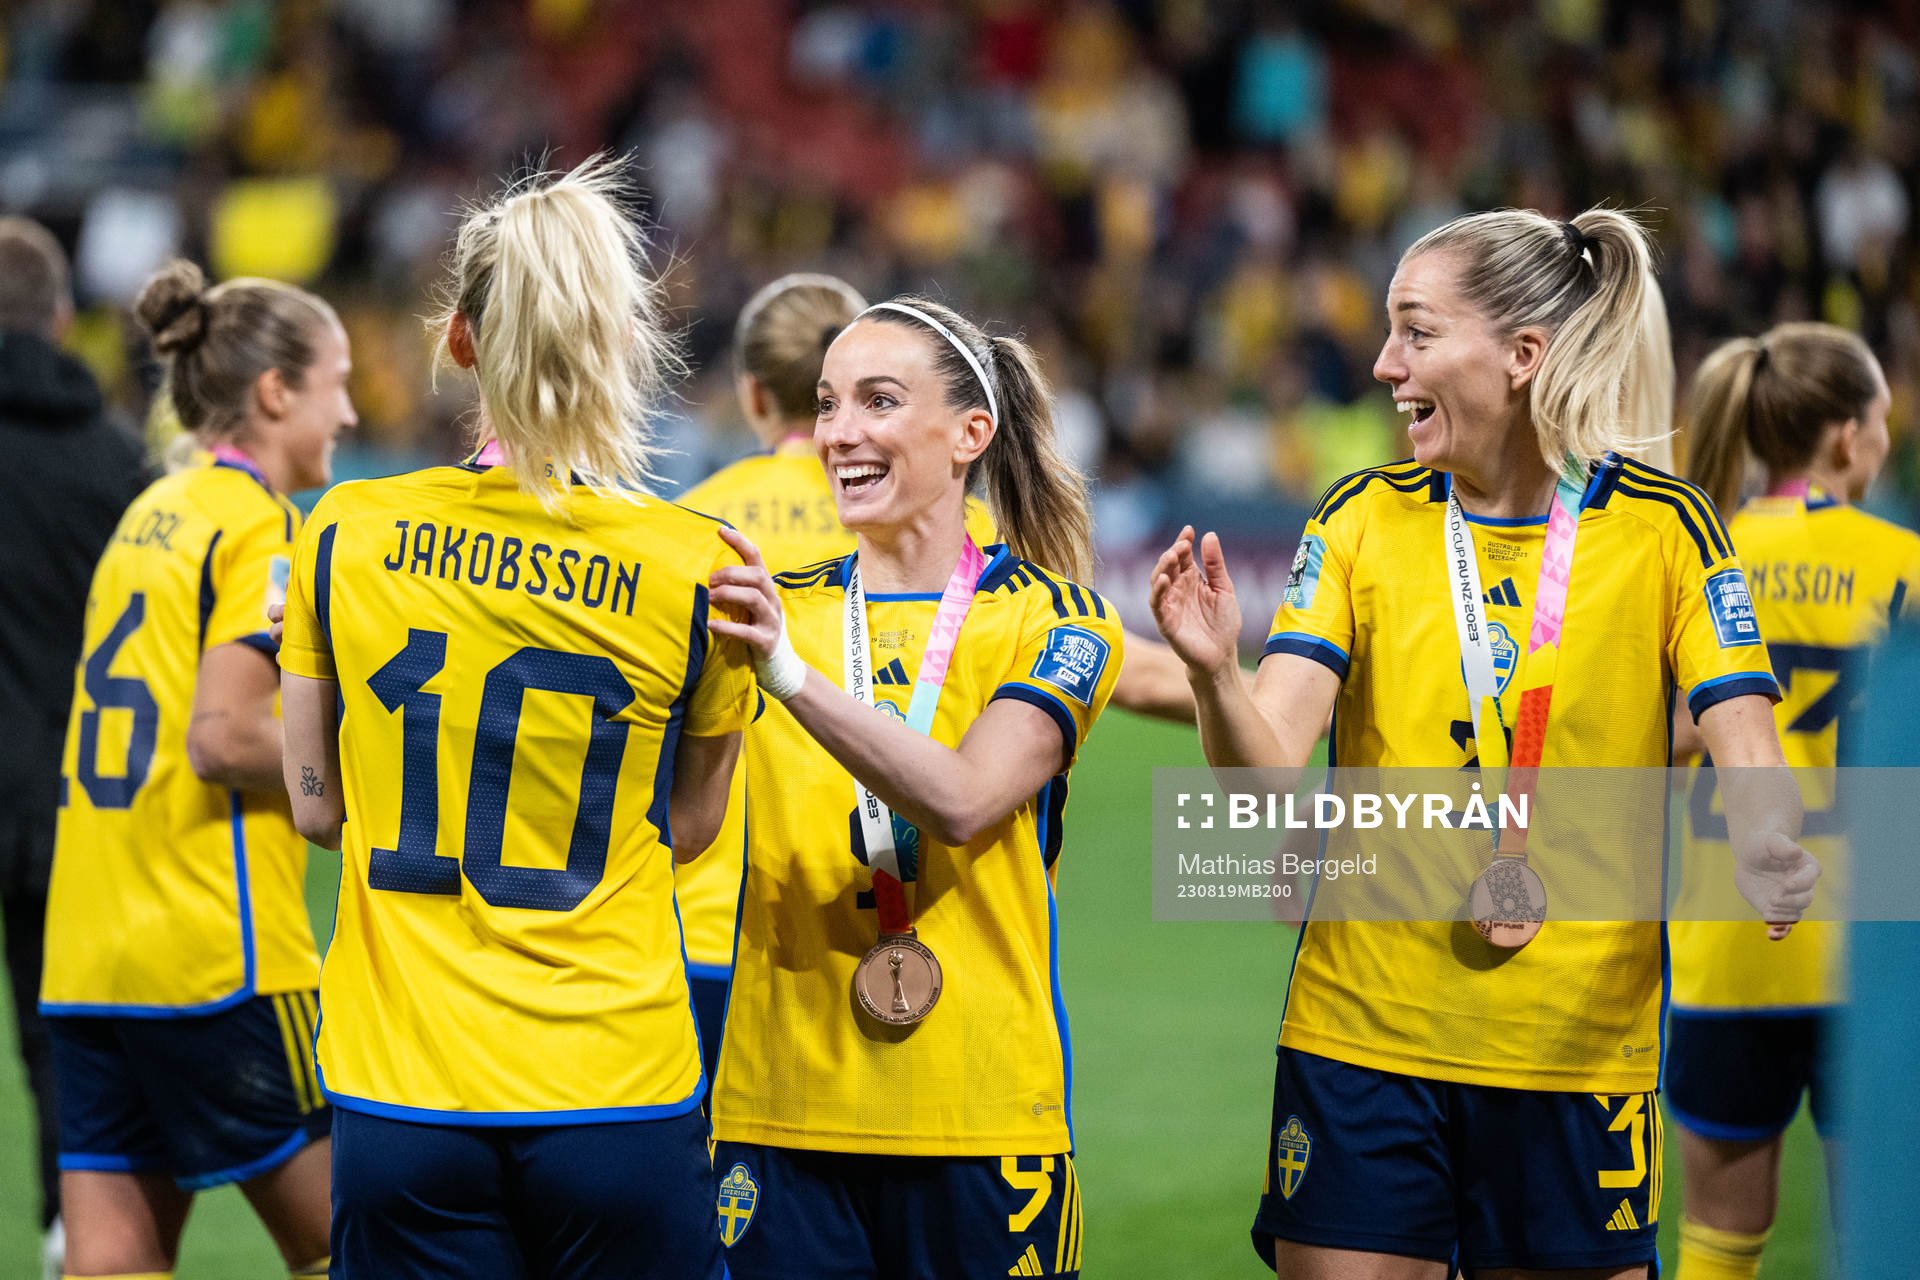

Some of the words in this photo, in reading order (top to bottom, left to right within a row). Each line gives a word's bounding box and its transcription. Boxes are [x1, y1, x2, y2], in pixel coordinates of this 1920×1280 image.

[1453, 532, 1465, 558] CUP
[384, 520, 642, 616] JAKOBSSON
[1750, 561, 1855, 606] NSSON
[851, 599, 861, 656] WOMEN'S
[1063, 635, 1099, 657] FOOTBALL
[852, 656, 865, 701] WORLD
[1052, 651, 1068, 665] the
[1067, 658, 1093, 681] World
[1060, 644, 1097, 668] UNITES
[1060, 670, 1077, 683] FIFA
[58, 592, 159, 809] 6
[367, 627, 636, 912] 10
[865, 788, 879, 819] 023
[1593, 1094, 1647, 1188] 3
[723, 1188, 751, 1198] SVERIGE
[1001, 1156, 1054, 1232] 9
